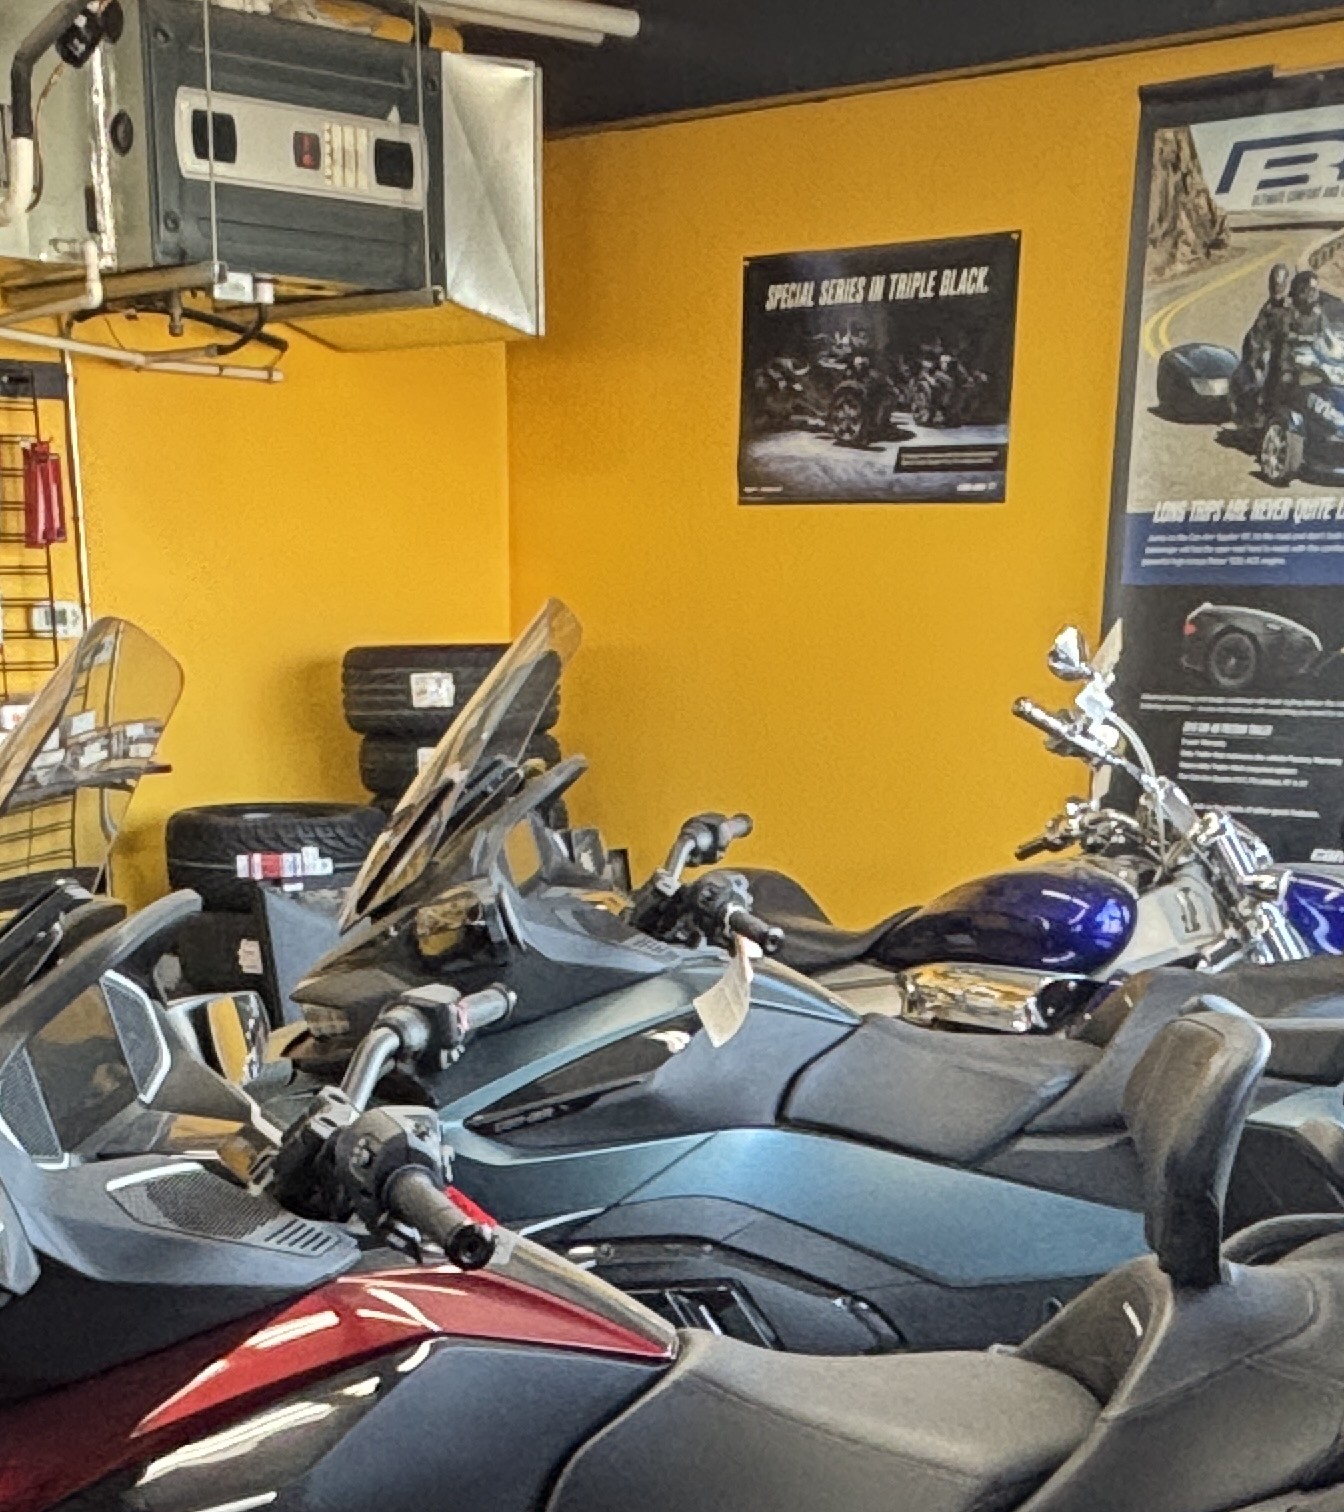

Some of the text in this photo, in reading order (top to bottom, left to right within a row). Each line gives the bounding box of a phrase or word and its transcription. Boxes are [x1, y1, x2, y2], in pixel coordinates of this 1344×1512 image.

[765, 266, 990, 311] SPECIAL SERIES IN TRIPLE BLACK.
[1153, 500, 1188, 523] LONG
[1189, 499, 1224, 522] TRIPS
[1223, 499, 1250, 522] ARE
[1250, 498, 1293, 521] NEVER
[1293, 497, 1336, 525] QUITE
